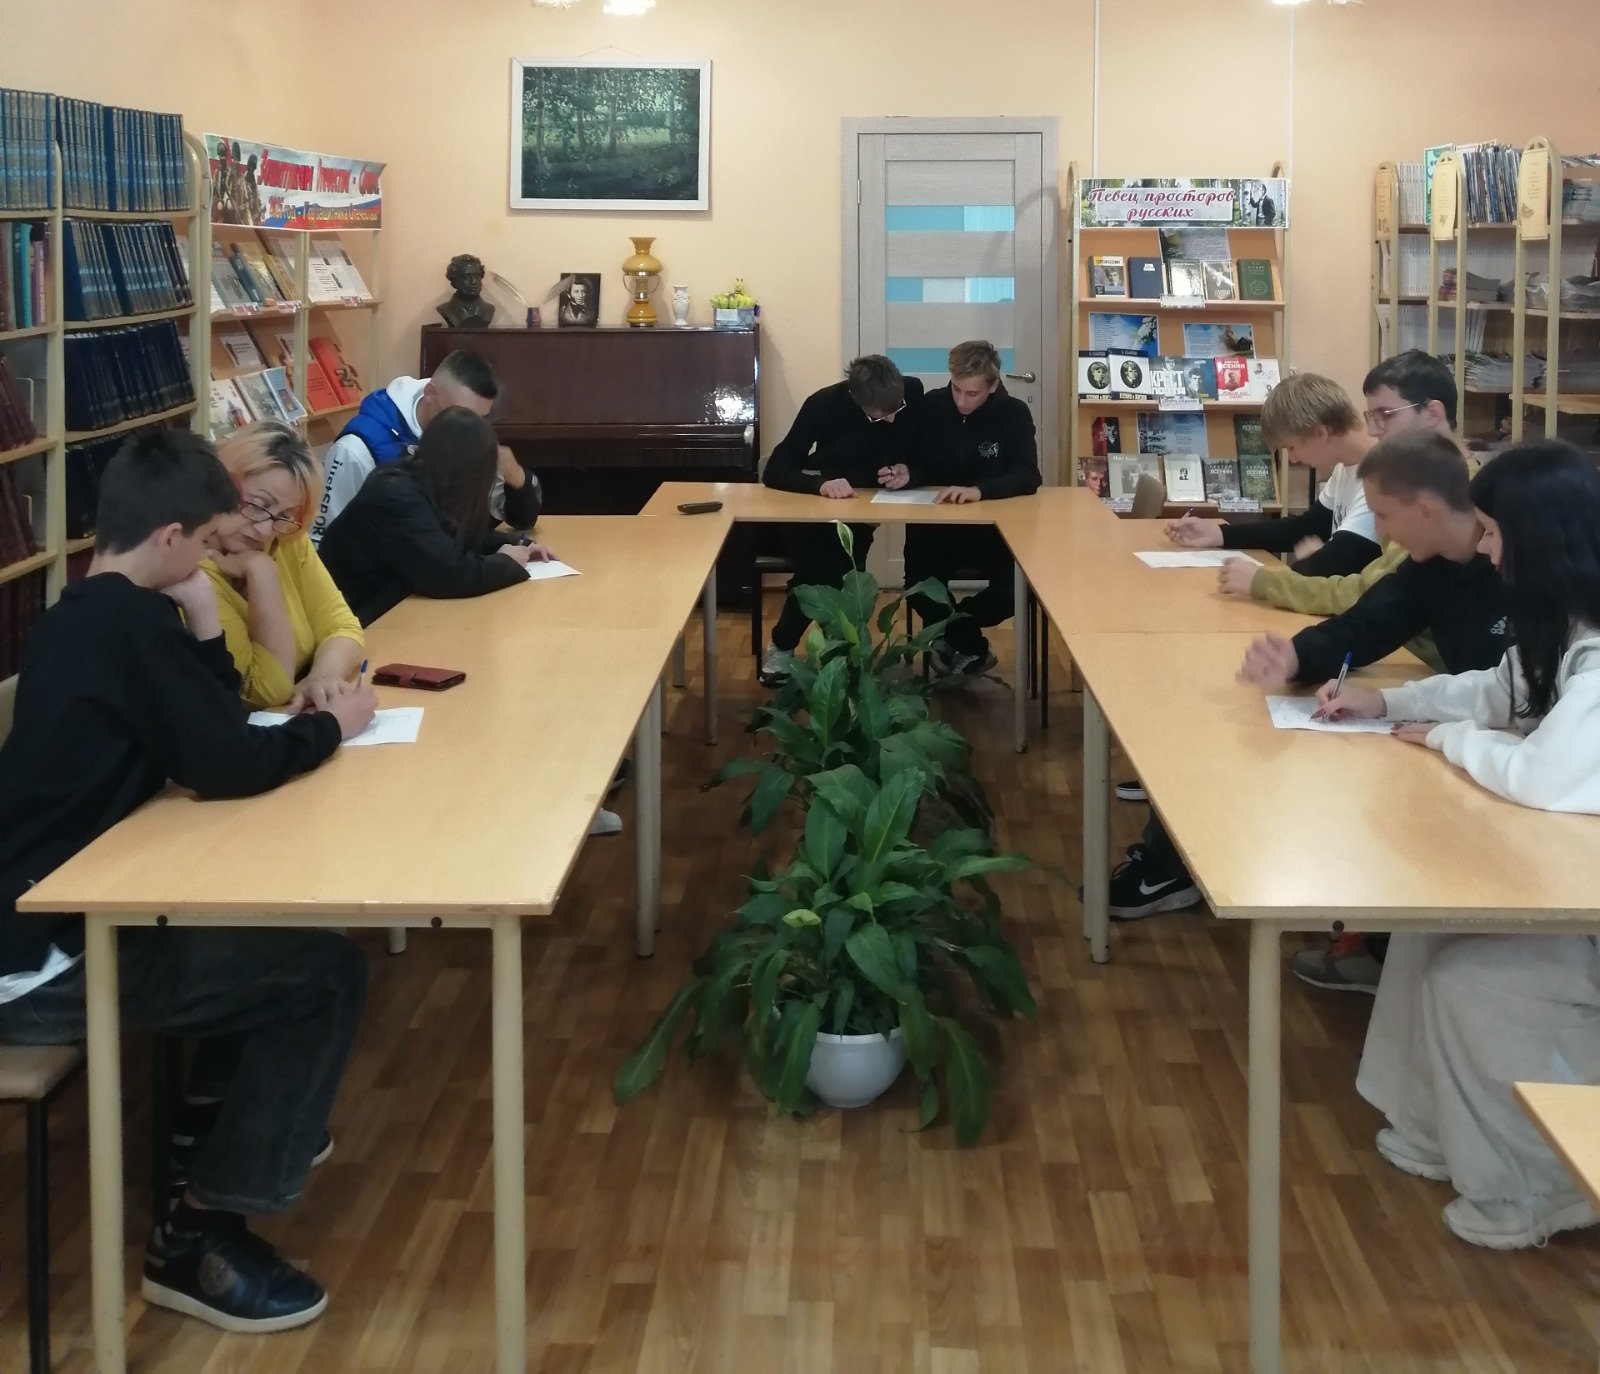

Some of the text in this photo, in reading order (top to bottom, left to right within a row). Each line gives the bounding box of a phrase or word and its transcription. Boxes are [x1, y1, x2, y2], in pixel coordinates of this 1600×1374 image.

[1088, 188, 1236, 206] Певец просторов
[1126, 206, 1194, 221] русских
